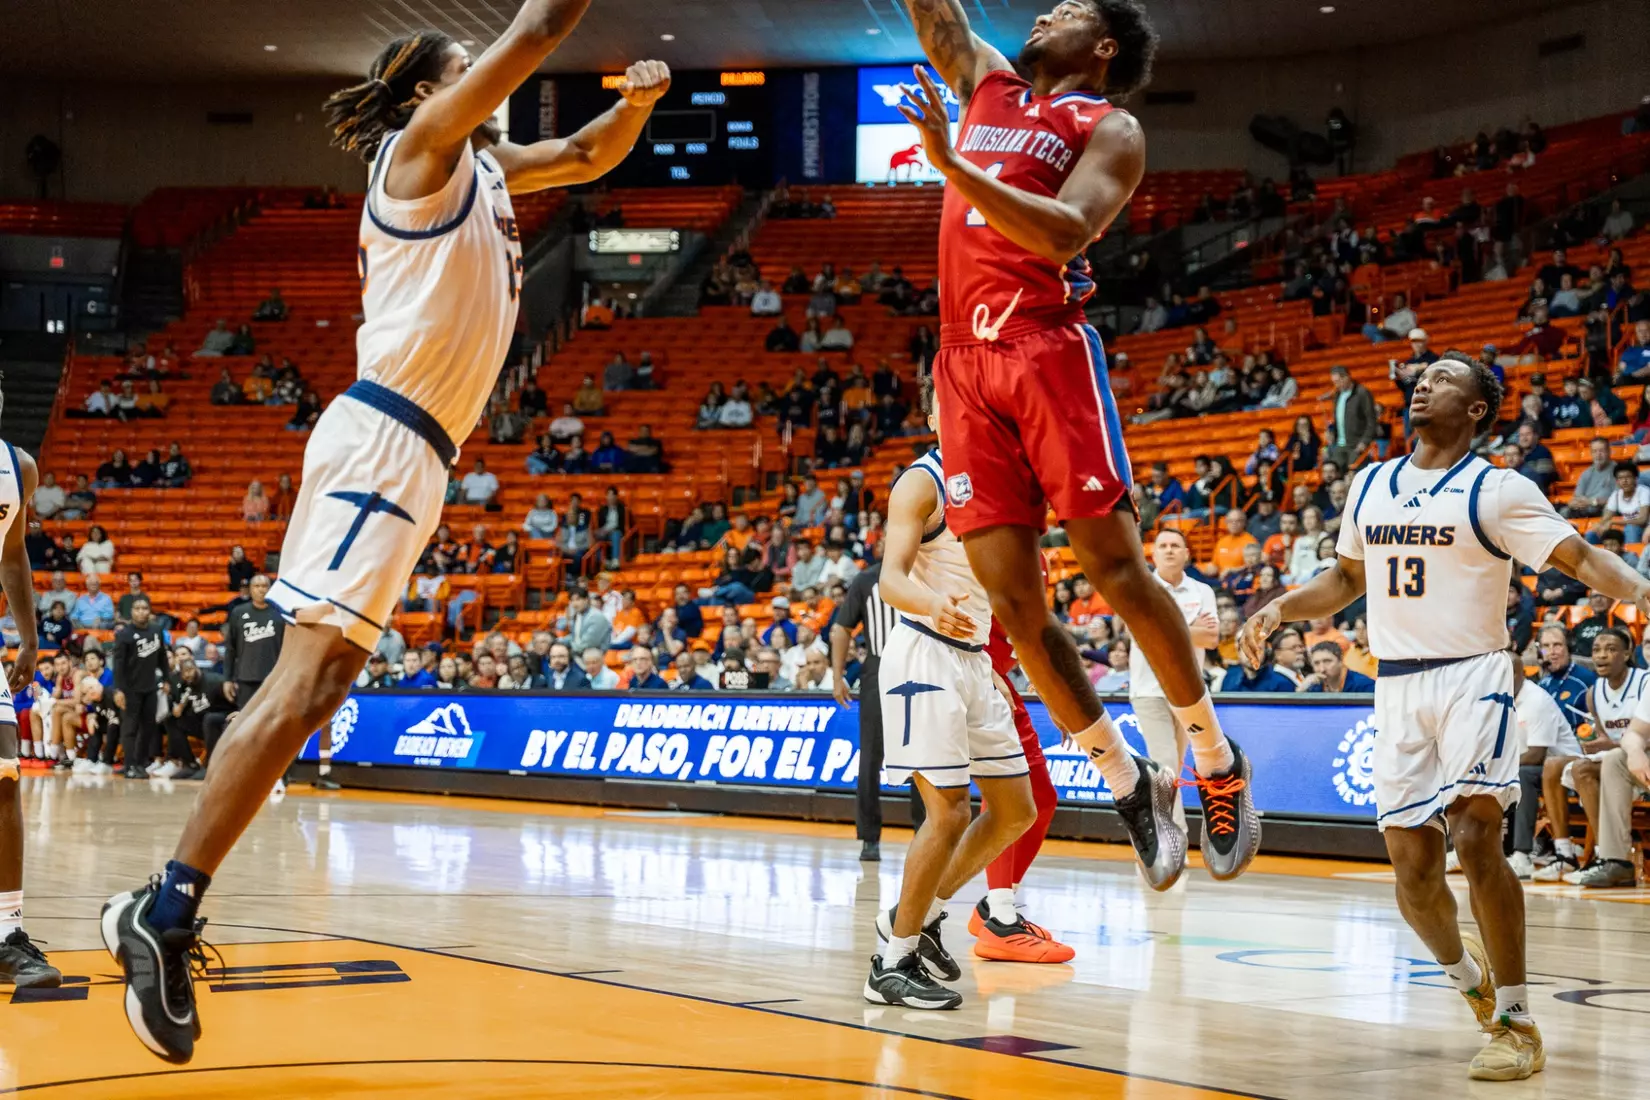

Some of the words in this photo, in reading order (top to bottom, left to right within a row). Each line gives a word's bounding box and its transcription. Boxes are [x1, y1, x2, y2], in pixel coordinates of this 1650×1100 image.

[960, 124, 1033, 152] LOUISIANA
[1026, 130, 1073, 172] TECH
[1365, 525, 1455, 546] MINERS
[1387, 556, 1425, 598] 13
[243, 620, 275, 642] Tech
[614, 703, 731, 731] DEADBEACH
[730, 706, 836, 732] BREWERY
[520, 729, 568, 768] BY
[562, 731, 599, 770] EL
[599, 732, 694, 780] PASO,
[699, 735, 774, 778] FOR
[773, 737, 815, 781] EL
